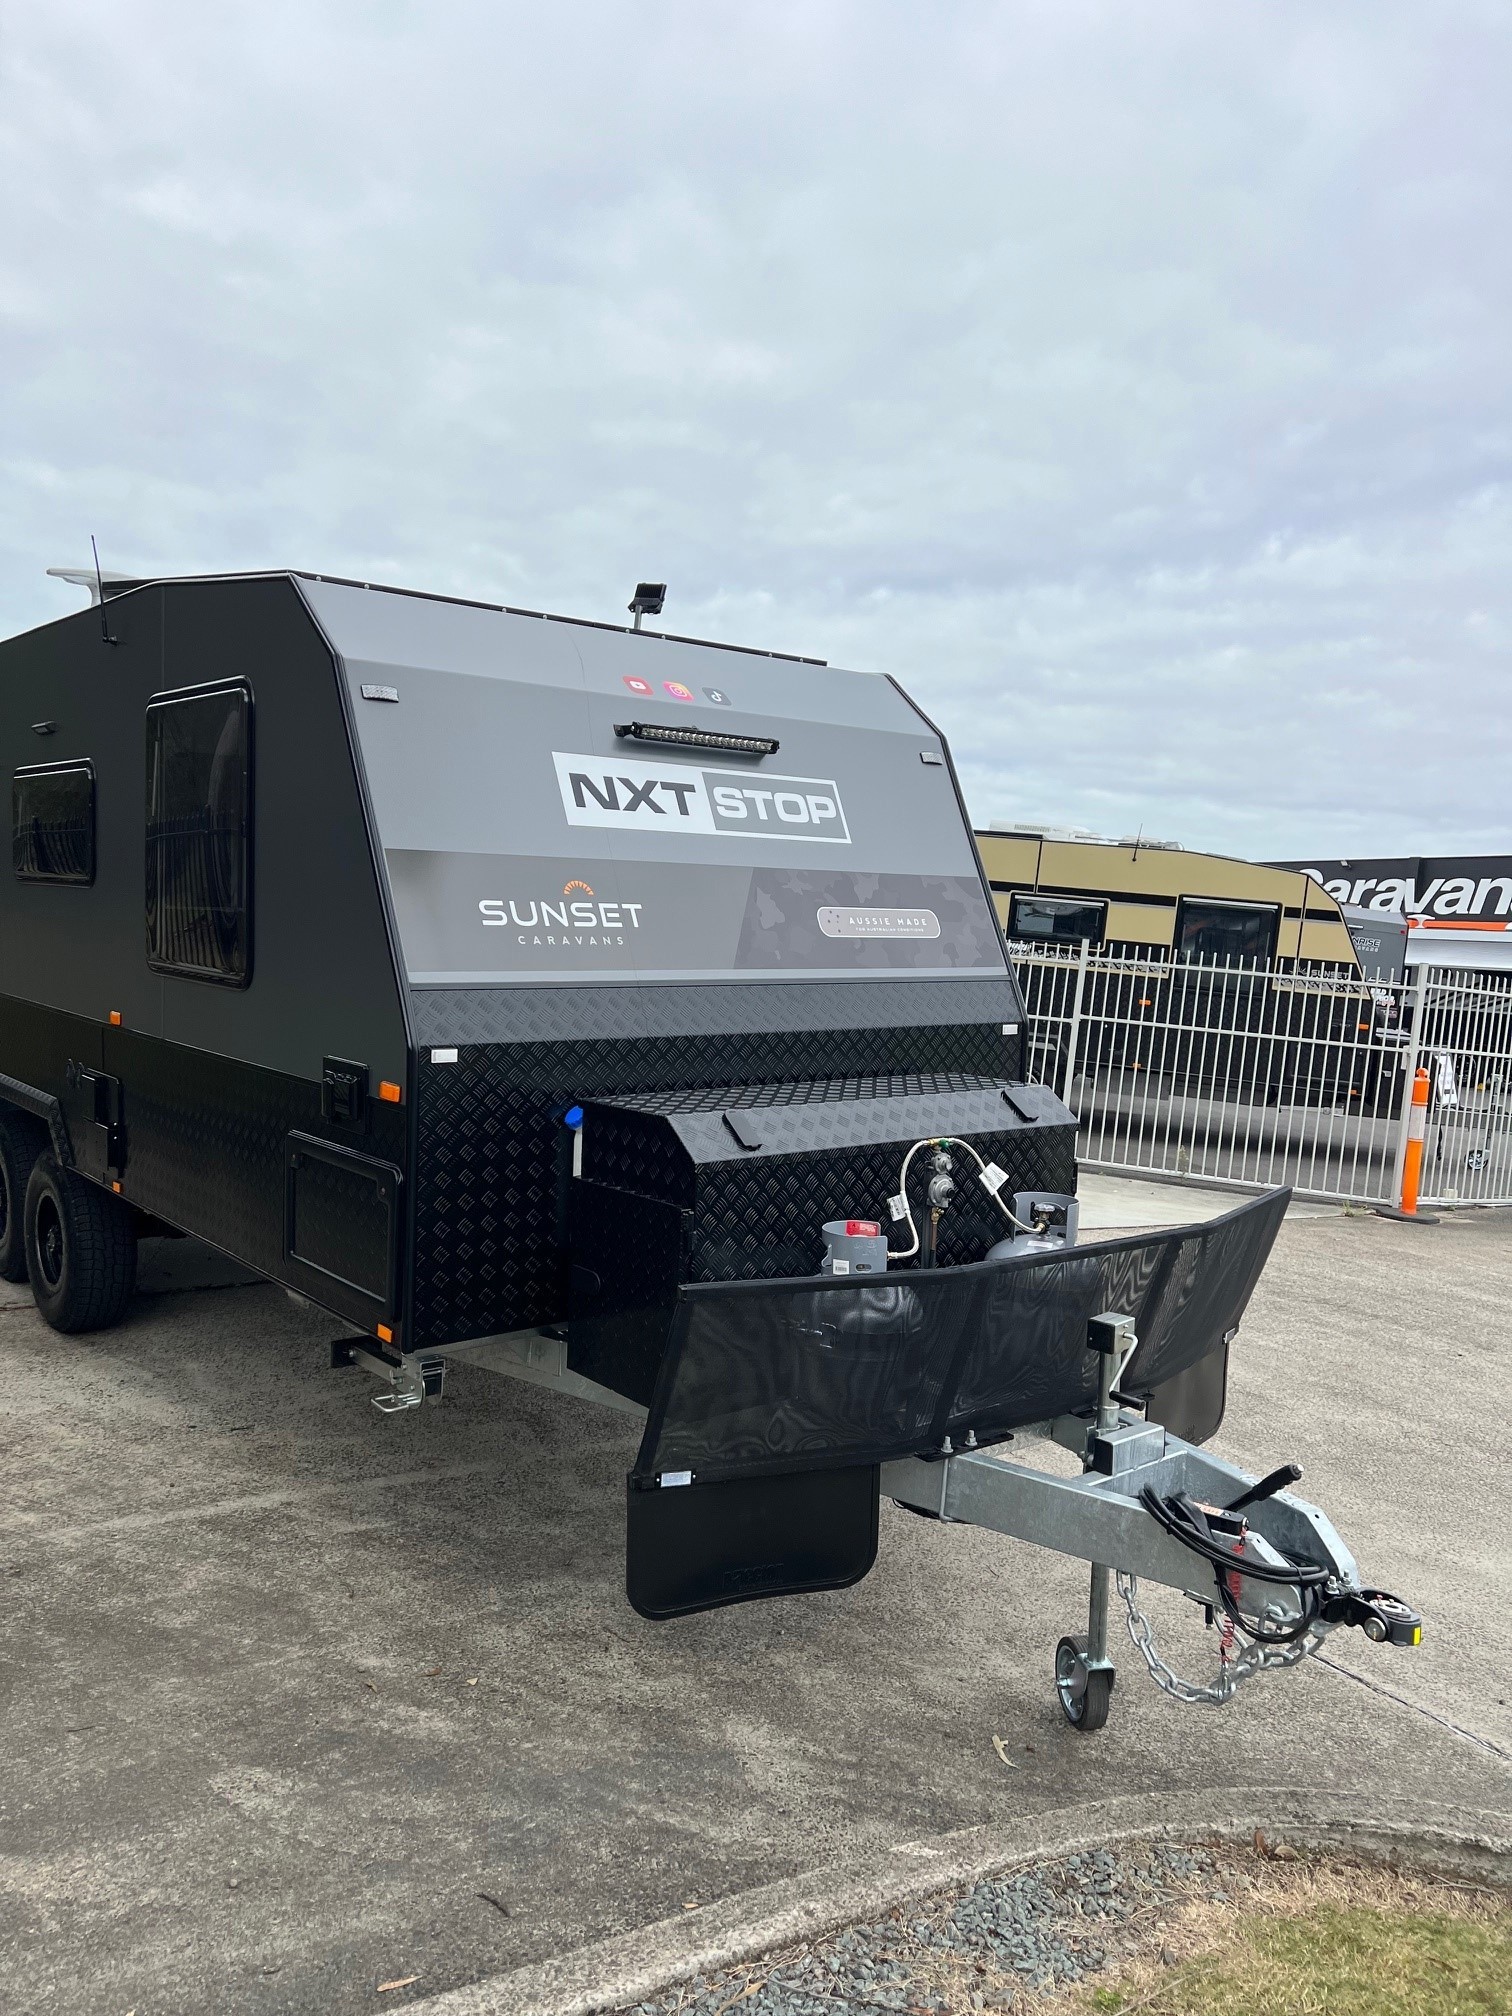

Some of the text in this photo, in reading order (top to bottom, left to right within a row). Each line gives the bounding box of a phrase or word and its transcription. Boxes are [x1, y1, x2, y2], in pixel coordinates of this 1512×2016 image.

[568, 772, 836, 824] NXT STOP
[478, 900, 643, 928] SUNSET
[849, 917, 928, 926] AUSSIE MADE
[518, 935, 624, 946] CARAVANS
